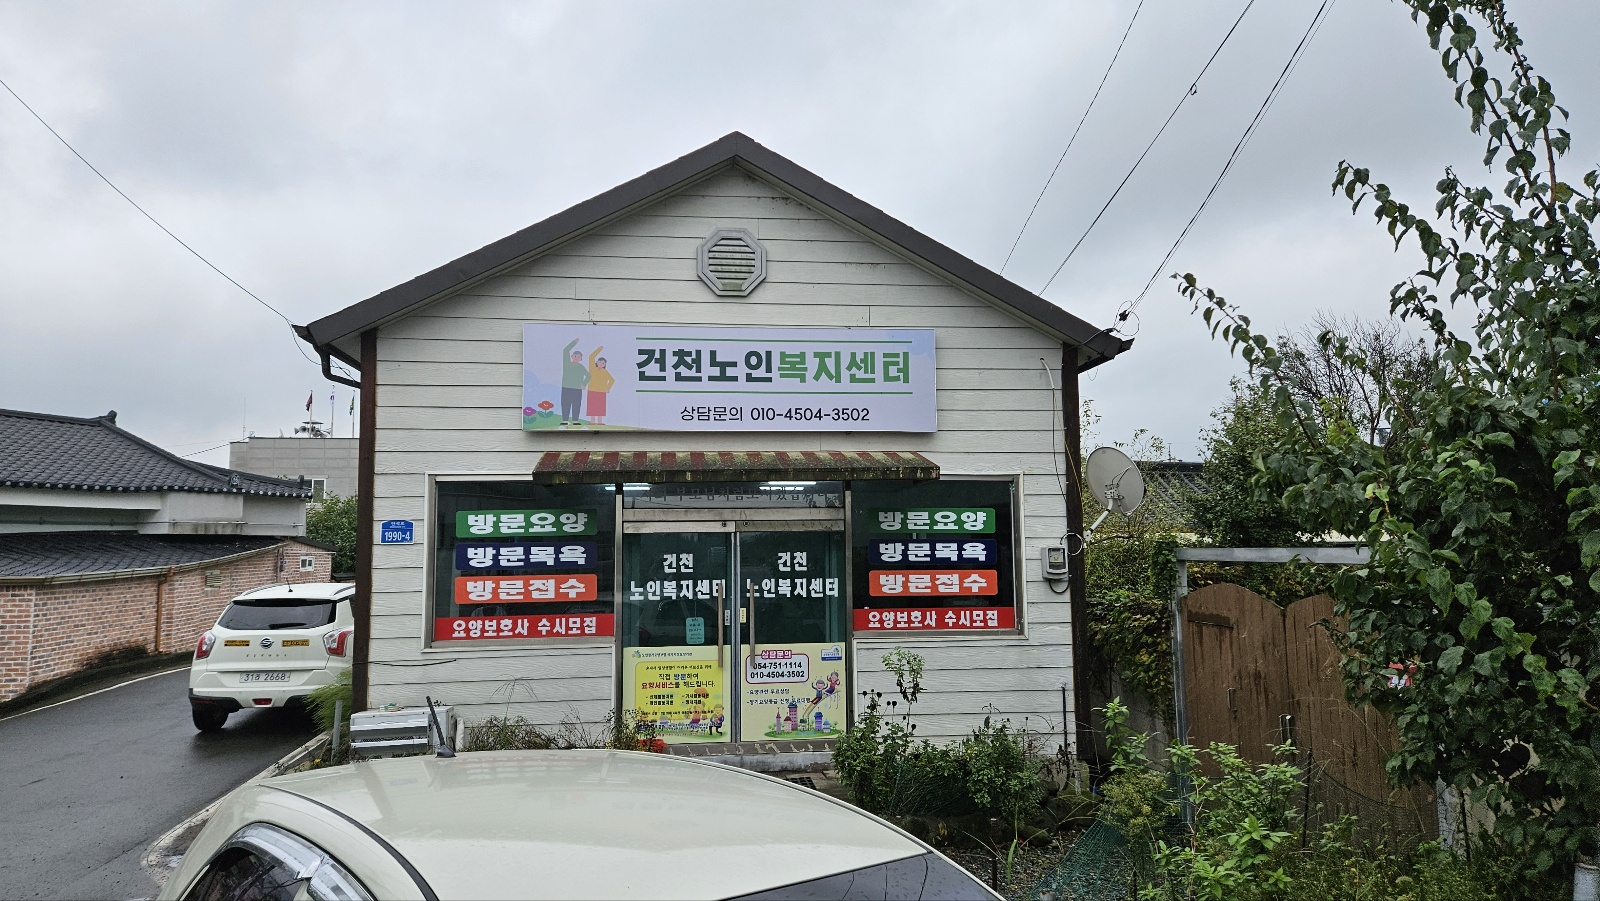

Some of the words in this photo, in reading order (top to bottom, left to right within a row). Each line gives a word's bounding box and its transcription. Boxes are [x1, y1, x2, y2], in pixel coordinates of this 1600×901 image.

[635, 347, 911, 384] 건천노인복지센터
[680, 405, 744, 423] 상담문의
[749, 407, 871, 422] 010-4504-3502
[467, 512, 588, 535] 방문요양
[878, 511, 987, 531] 방문요양
[384, 531, 411, 541] 1990-4
[467, 545, 587, 568] 방문목욕
[777, 551, 808, 572] 건천
[878, 542, 987, 562] 방문목욕
[663, 553, 694, 573] 건천
[466, 578, 586, 601] 방문접수
[629, 579, 726, 601] 노인복지센터
[746, 577, 839, 598] 노인복지센터
[879, 573, 988, 594] 방문접수
[452, 618, 529, 638] 요양보호사
[537, 616, 597, 635] 수시모집
[868, 610, 937, 628] 요양보호사
[944, 610, 999, 627] 수시모집
[761, 650, 792, 659] 상담문의
[750, 670, 805, 679] 010-4504-3502
[752, 661, 803, 670] 054-751-1114
[264, 672, 286, 681] 2668
[658, 673, 671, 681] 직접
